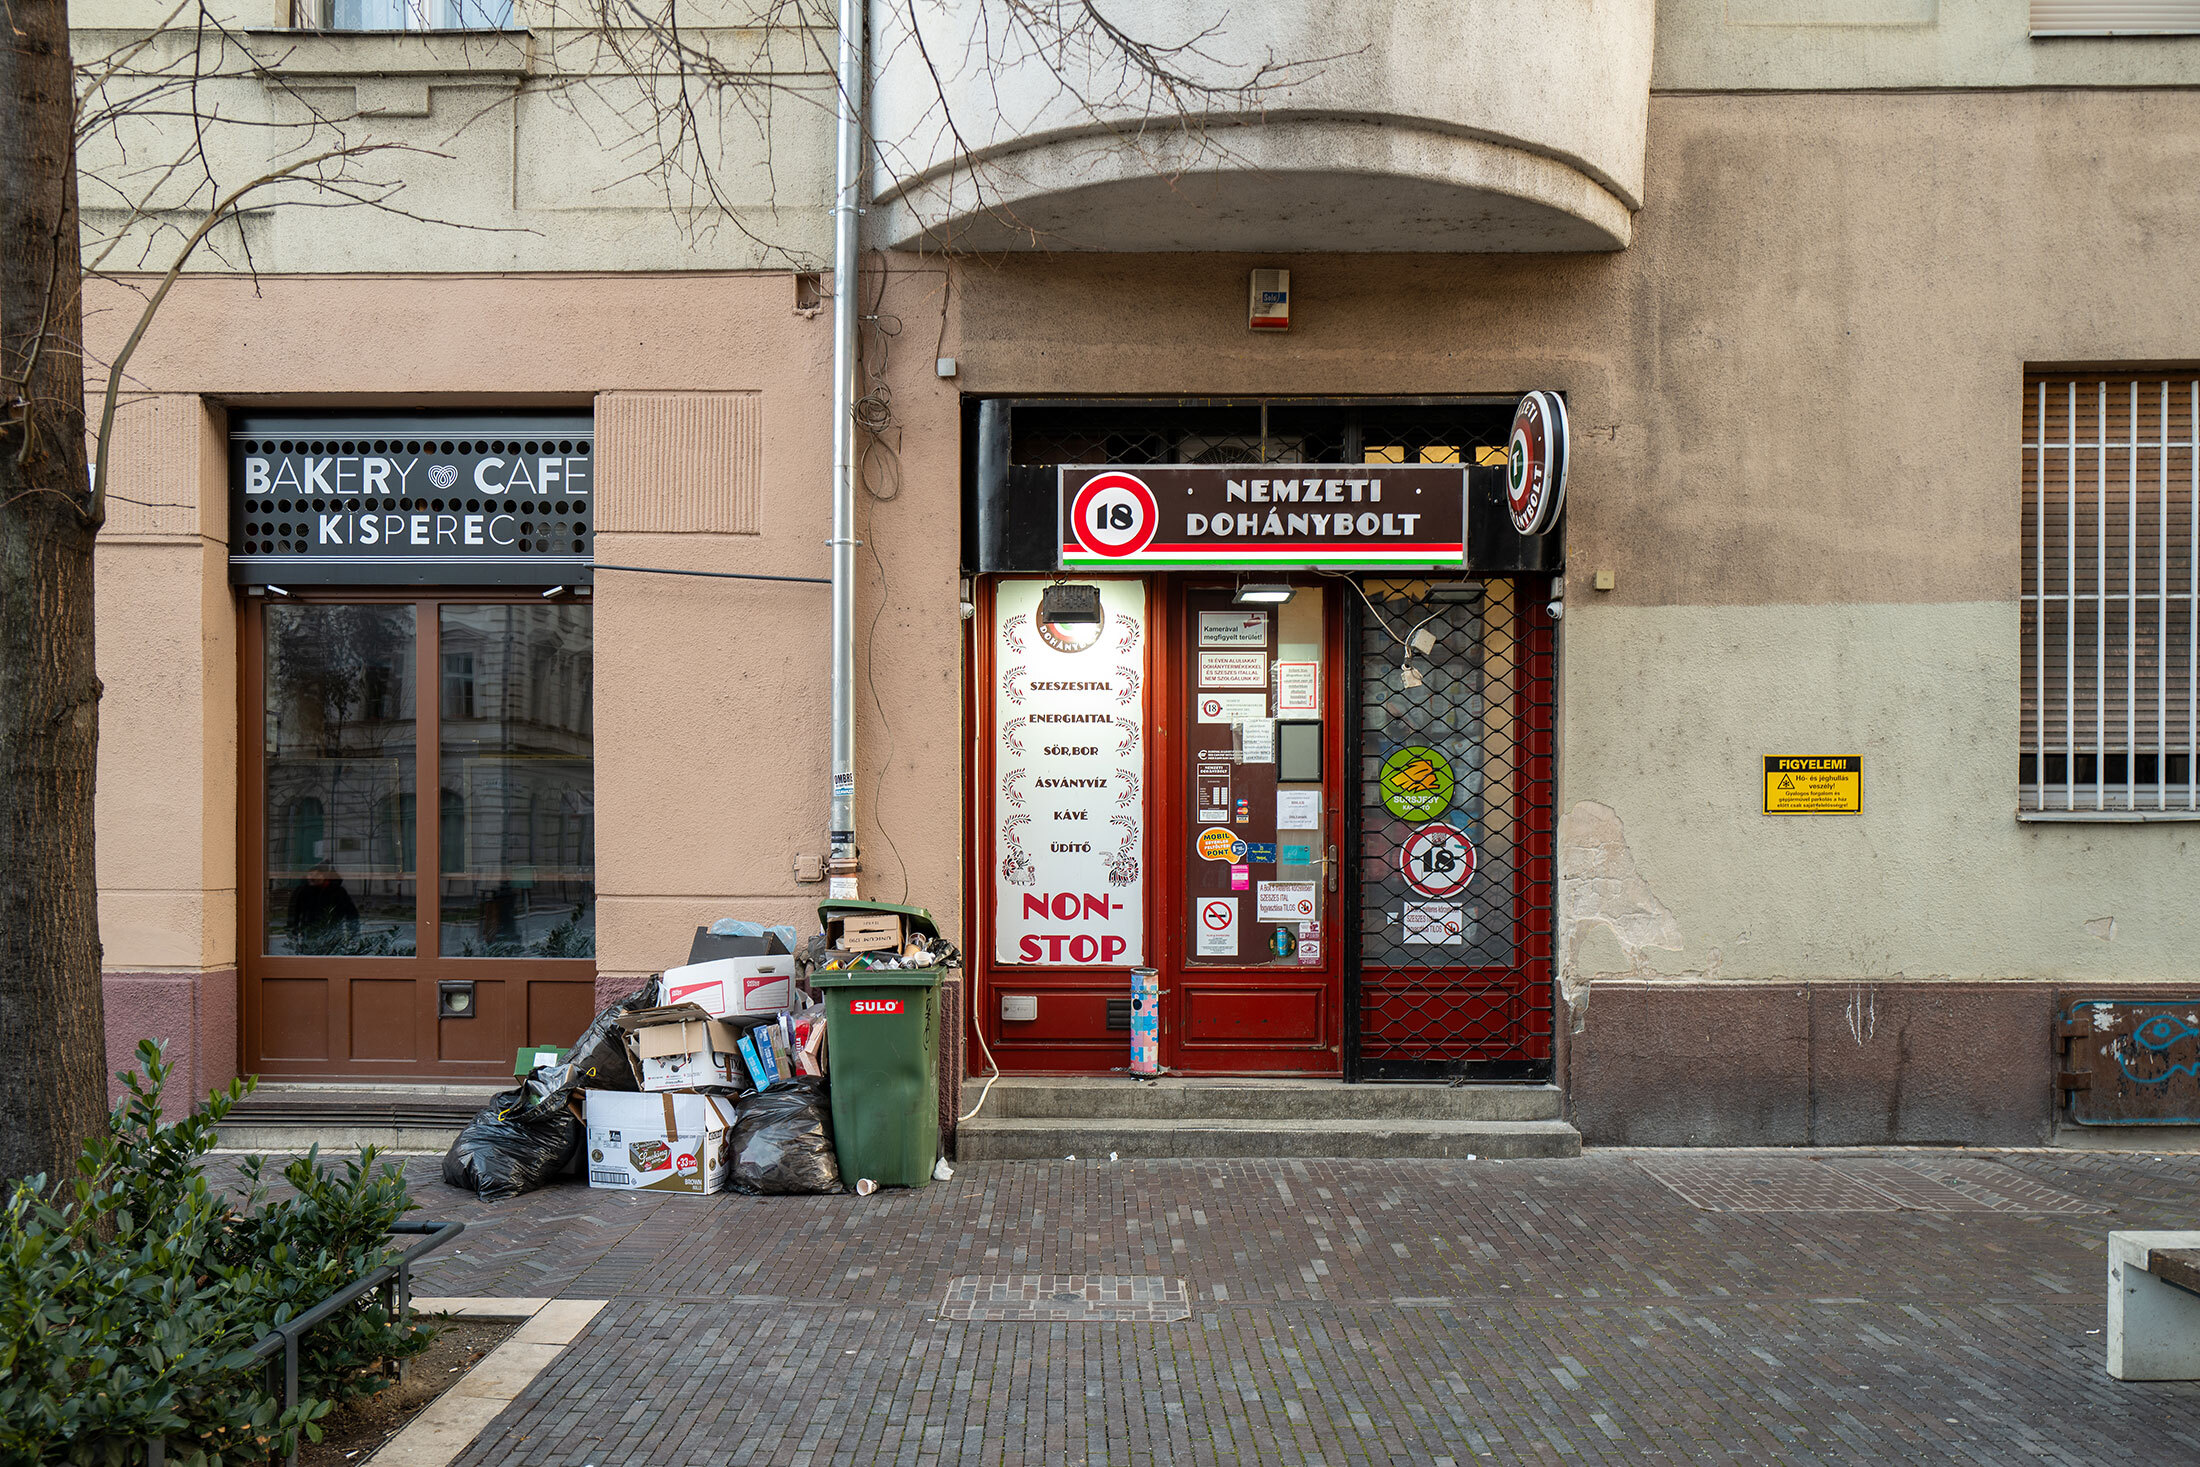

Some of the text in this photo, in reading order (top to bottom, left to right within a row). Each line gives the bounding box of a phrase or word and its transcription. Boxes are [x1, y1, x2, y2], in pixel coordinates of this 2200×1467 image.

[1511, 449, 1520, 477] T
[245, 456, 589, 495] BAKERY CAFE
[1226, 479, 1382, 503] NEMZETI
[1096, 502, 1134, 530] 18
[1186, 505, 1422, 537] DOHÁNYBOLT
[318, 513, 516, 546] KISPEREC
[1203, 625, 1239, 633] Kamerával
[1203, 634, 1238, 642] megfigyelt
[1029, 681, 1113, 692] SZESZESITAL
[1207, 703, 1217, 713] 18
[1028, 713, 1114, 724] ENERGIAITAL
[1043, 745, 1099, 757] SÖR,BOR
[1779, 759, 1847, 770] FIGYELEM!
[1034, 775, 1108, 789] ÁSVÁNYVÍZ
[1818, 774, 1849, 783] jéghullás
[1053, 808, 1089, 822] KÁVÉ
[1203, 833, 1230, 841] MOBIL
[1050, 841, 1092, 854] ÜDÍTŐ
[1206, 849, 1230, 857] PONT
[1422, 849, 1456, 873] 18
[1022, 892, 1125, 922] NON-
[1018, 934, 1127, 964] STOP
[854, 1001, 897, 1012] SULO
[684, 1178, 702, 1186] BROWN
